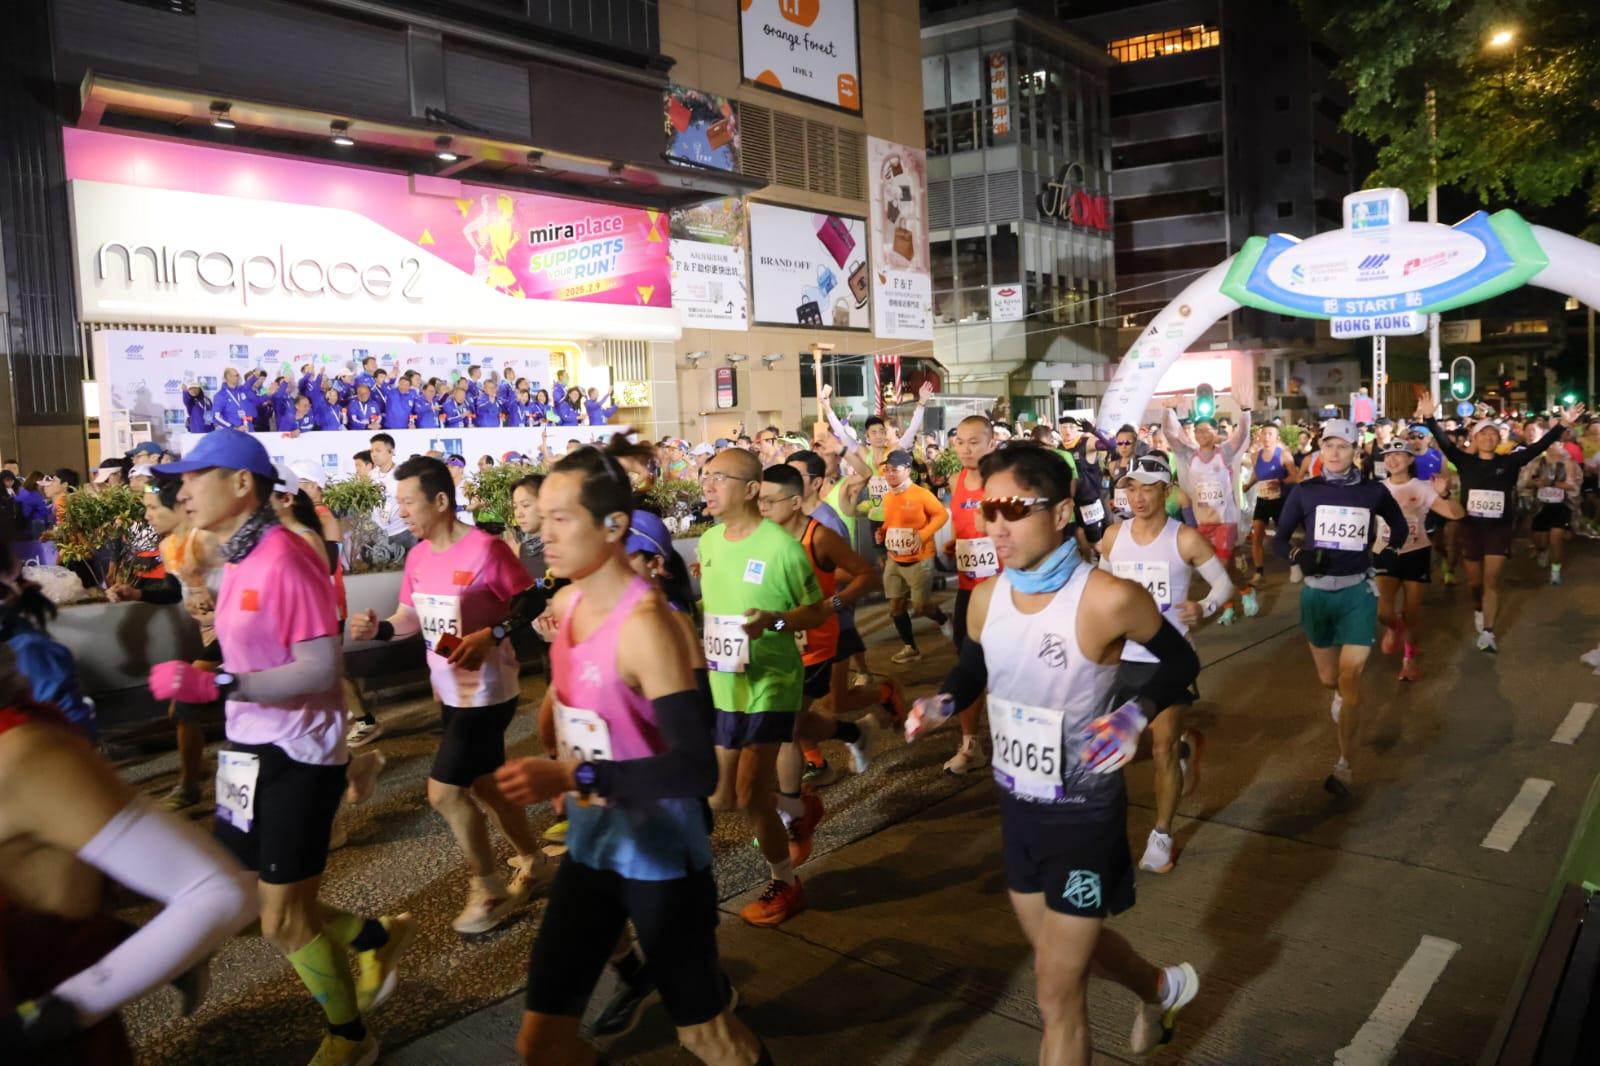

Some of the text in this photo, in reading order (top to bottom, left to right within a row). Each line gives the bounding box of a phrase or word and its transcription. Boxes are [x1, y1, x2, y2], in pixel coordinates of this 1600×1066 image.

[763, 24, 837, 58] orange forest
[1069, 191, 1112, 231] ONE
[530, 217, 622, 244] miraplace
[530, 238, 624, 273] SUPPORTS
[760, 256, 792, 267] BRAND
[794, 261, 811, 270] OFF
[97, 241, 422, 307] miraplace 2
[574, 256, 617, 280] RUN!
[1345, 298, 1398, 314] START
[1335, 315, 1410, 332] HONG KONG
[1469, 501, 1502, 511] 15025
[1319, 522, 1366, 539] 14524
[958, 551, 996, 568] 12342
[995, 732, 1055, 775] 12065
